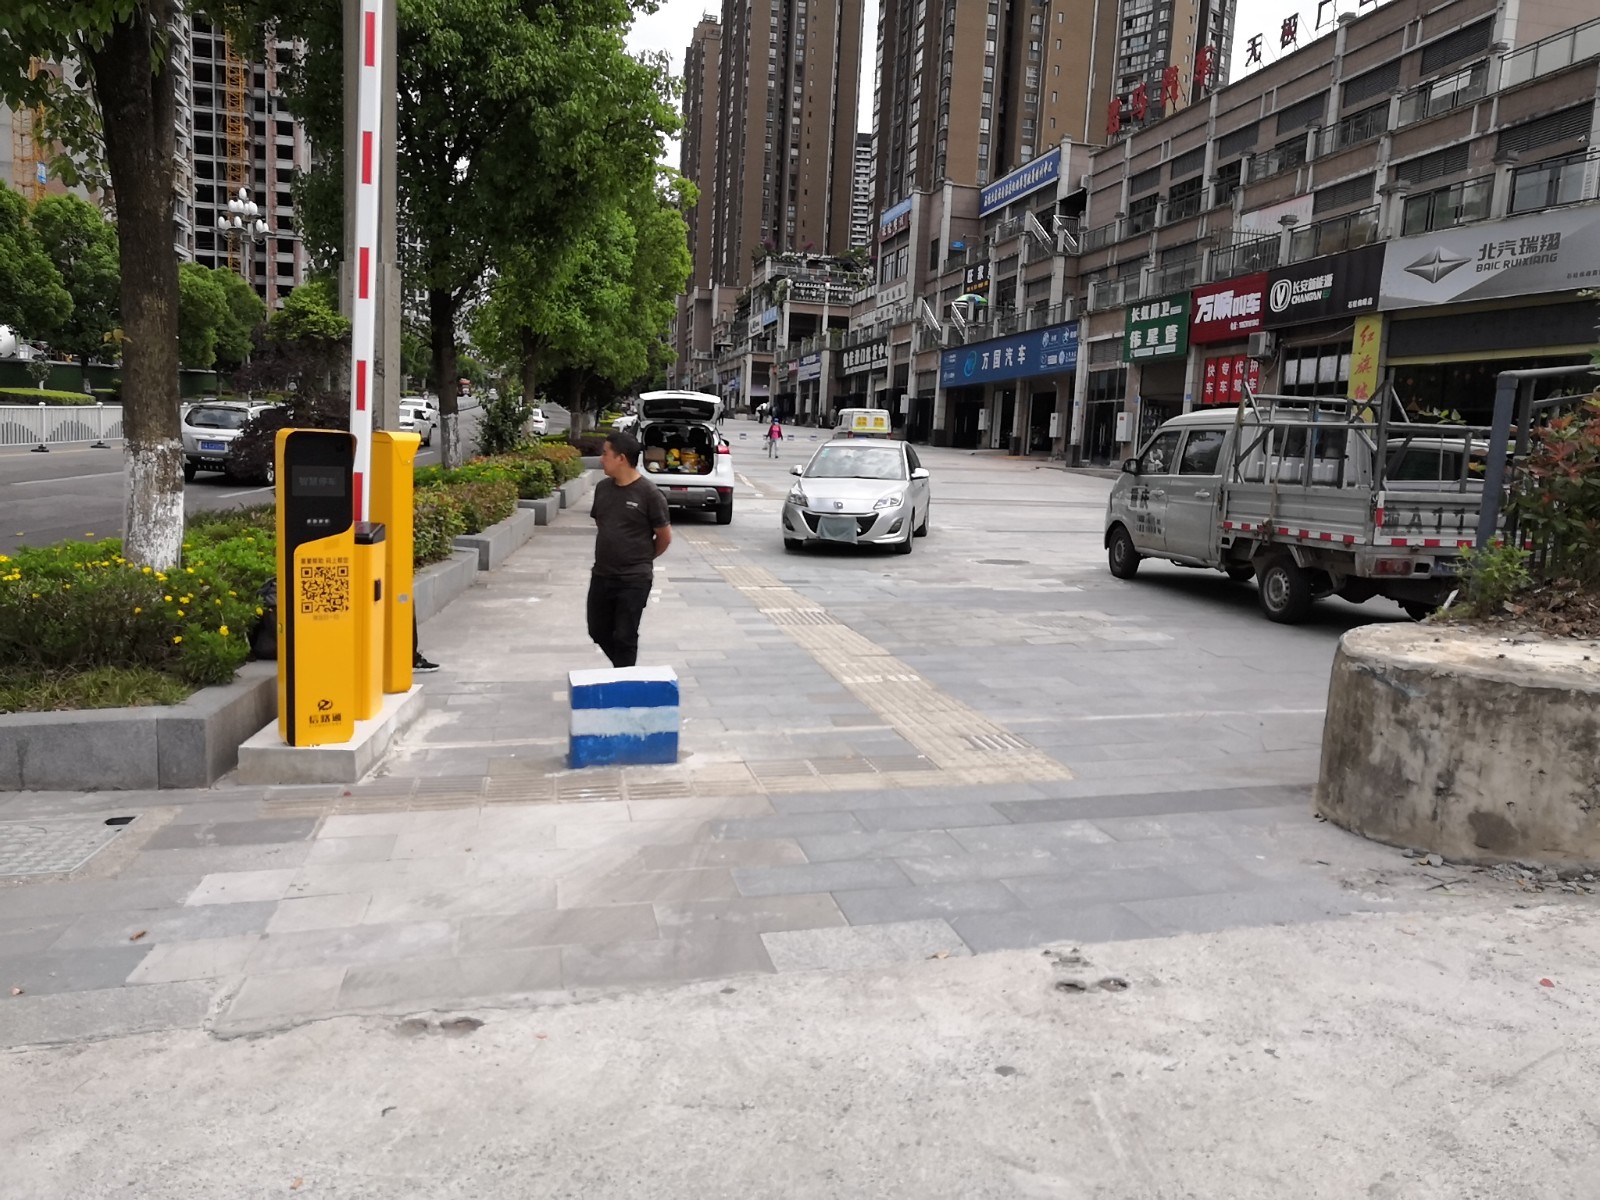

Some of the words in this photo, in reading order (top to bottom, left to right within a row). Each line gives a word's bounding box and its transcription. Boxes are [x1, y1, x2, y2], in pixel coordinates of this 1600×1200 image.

[1477, 232, 1561, 261] 北汽瑞翔
[1476, 261, 1501, 273] BAIC
[1503, 253, 1558, 269] RUIXIANG
[1293, 273, 1333, 294] 长安新能源
[1194, 290, 1261, 324] 万顺叫车
[1291, 290, 1322, 305] CHANGAN
[1129, 324, 1178, 349] 伟星管
[981, 344, 1026, 370] 万国汽车
[1205, 364, 1216, 394] 快车
[1219, 362, 1230, 394] 专车
[1233, 360, 1245, 393] 代驾
[1249, 359, 1260, 391] 拼车
[309, 713, 342, 724] 信路通
